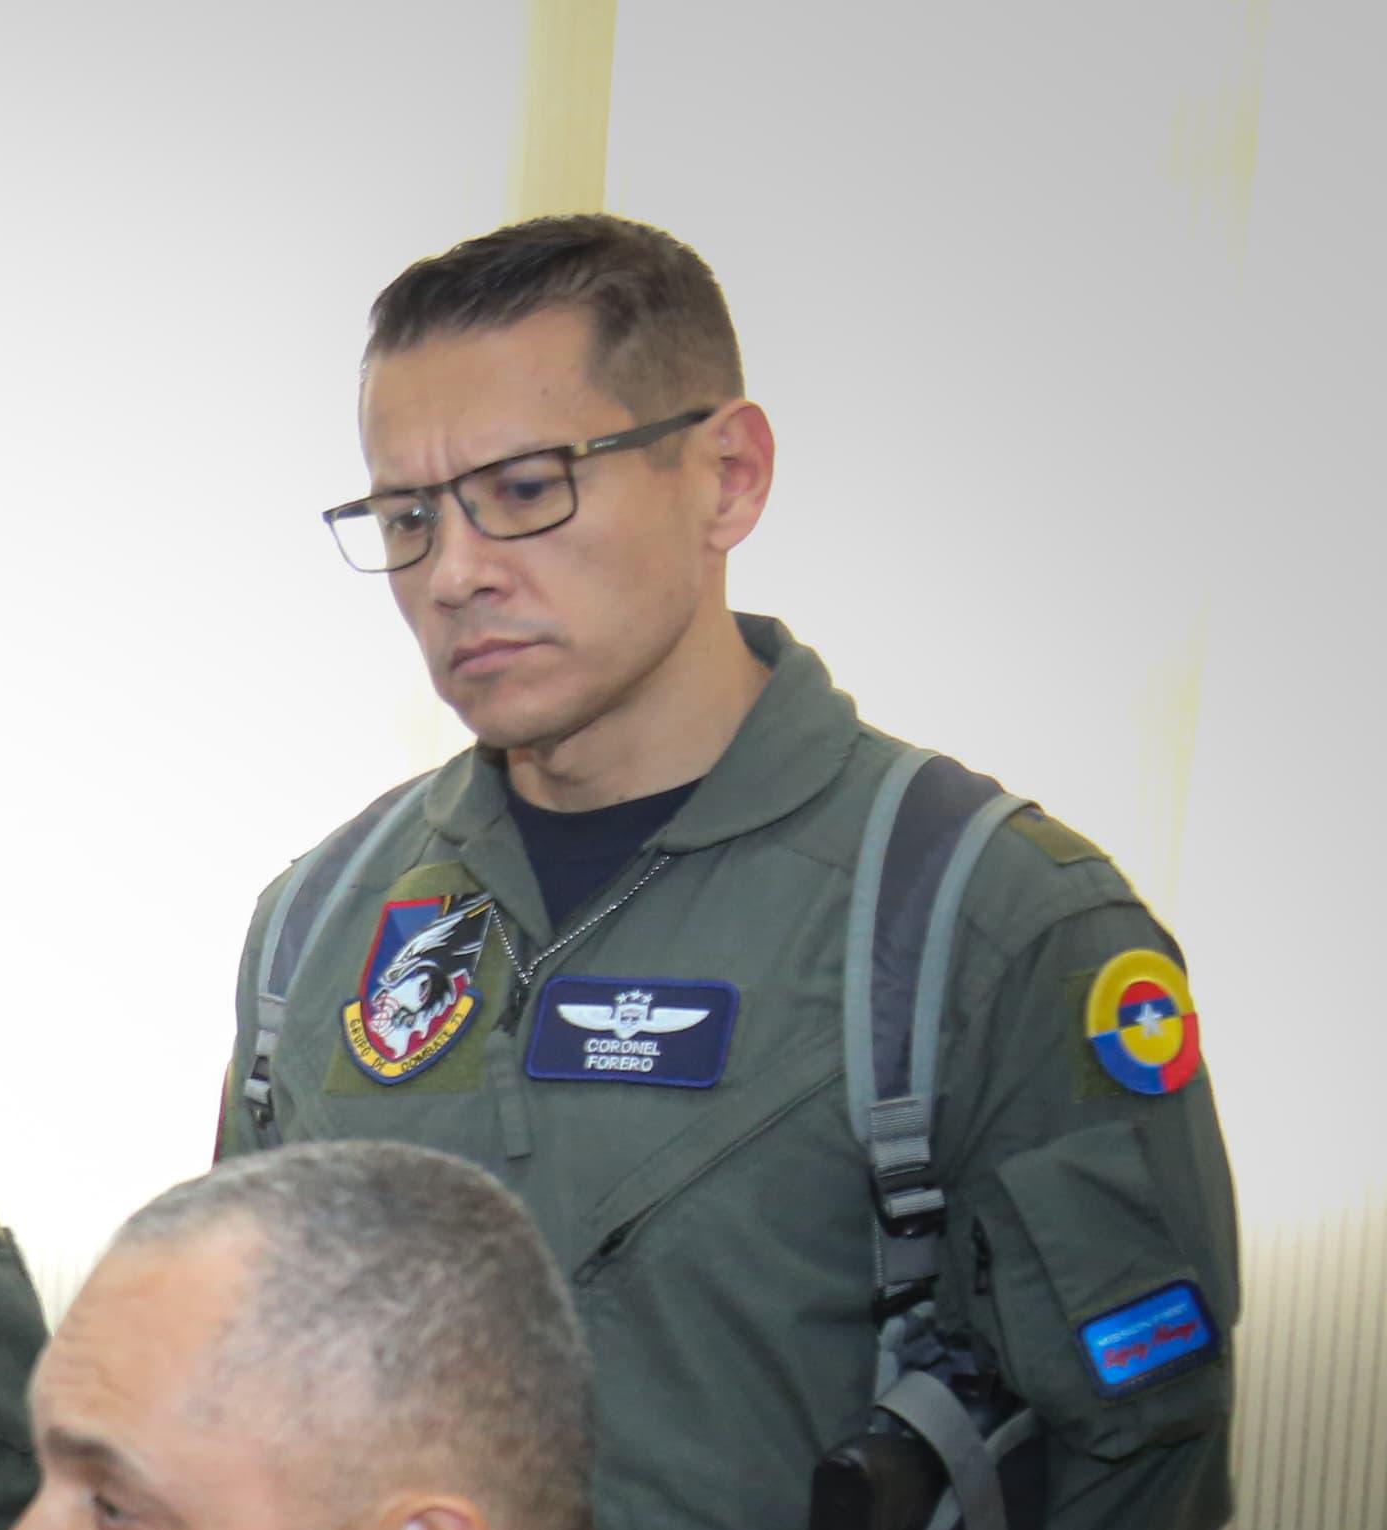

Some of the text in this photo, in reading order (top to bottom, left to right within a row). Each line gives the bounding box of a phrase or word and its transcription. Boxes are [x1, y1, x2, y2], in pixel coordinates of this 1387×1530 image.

[349, 1018, 370, 1056] GRUPO
[584, 1037, 661, 1057] CORONEL
[585, 1054, 654, 1073] FORERO
